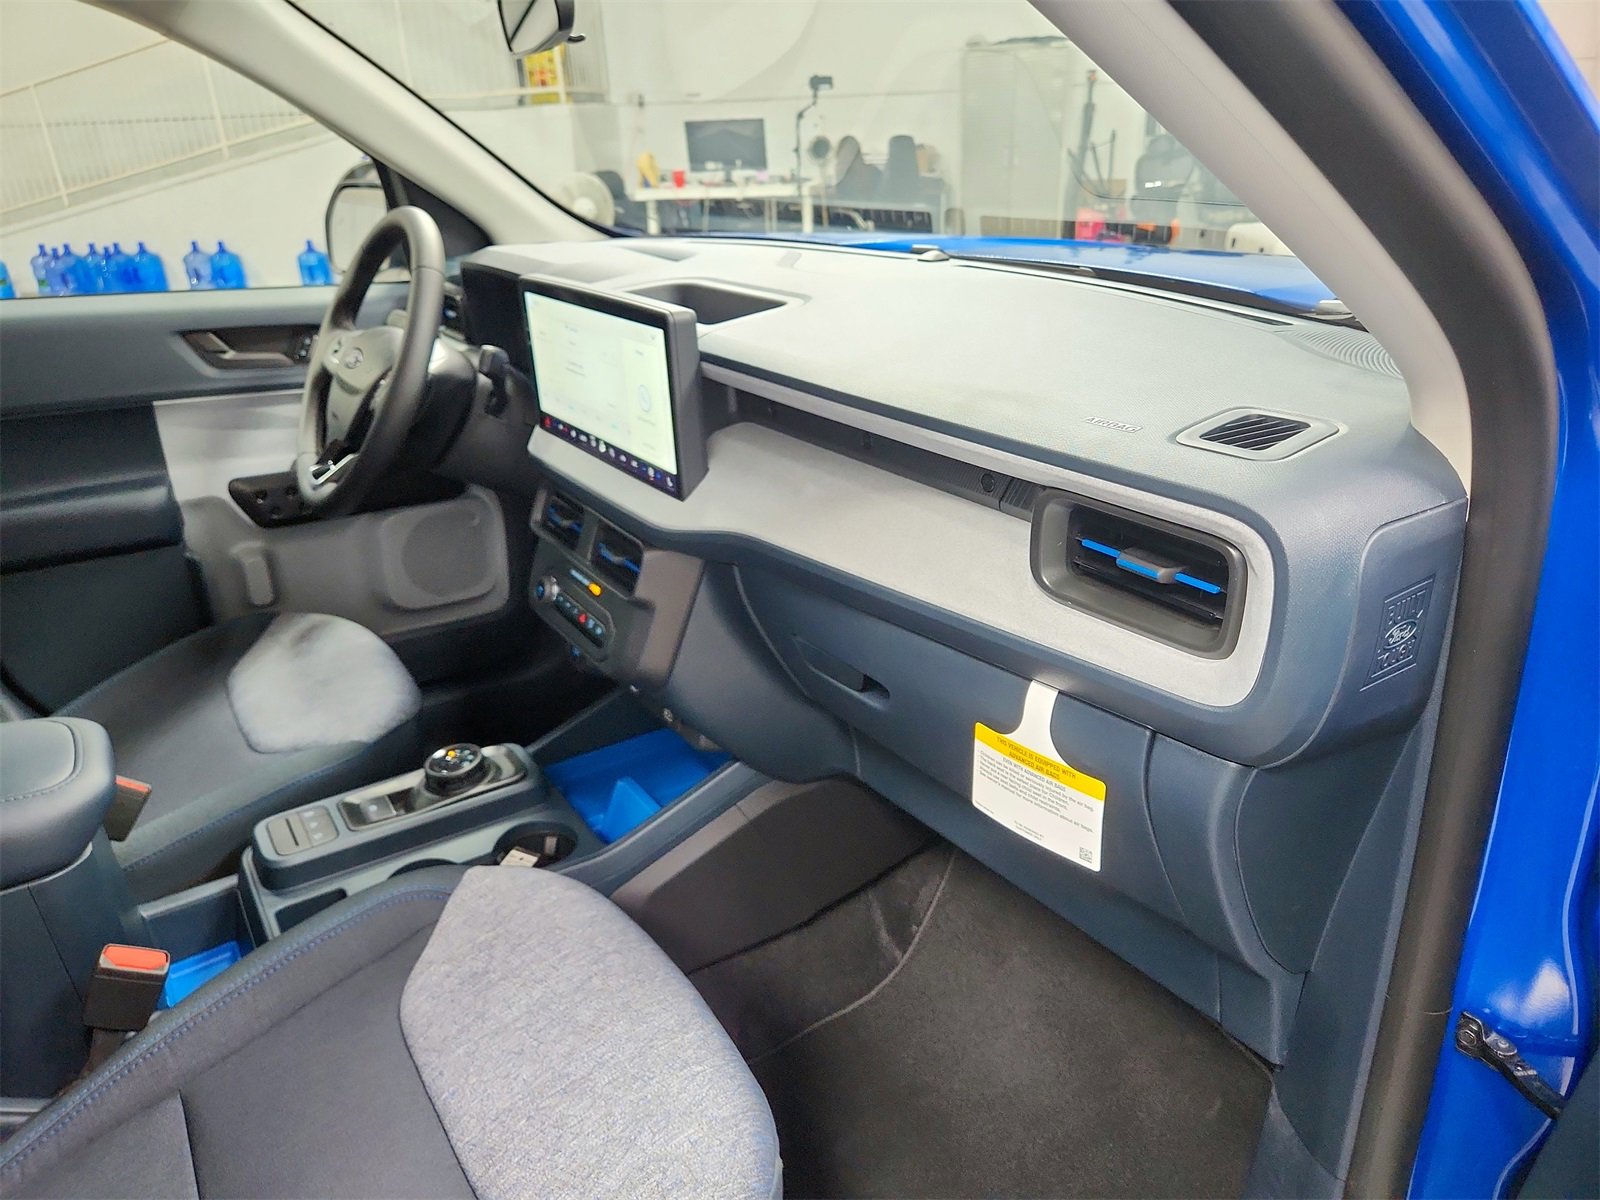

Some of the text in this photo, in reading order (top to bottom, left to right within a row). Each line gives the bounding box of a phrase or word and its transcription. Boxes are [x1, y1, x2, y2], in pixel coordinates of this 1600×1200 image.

[1083, 417, 1142, 433] AIRBAG
[1387, 590, 1427, 625] BUILT
[1388, 623, 1411, 644] Ford
[1377, 638, 1417, 668] TOUGH
[997, 737, 1007, 746] THIS
[1008, 743, 1026, 756] VEHICLE
[1035, 756, 1060, 772] EQUIPPED
[1062, 768, 1076, 779] WITH
[1009, 751, 1060, 780] ADVANCED AIR BAGS
[1014, 763, 1023, 771] WITH
[1025, 769, 1045, 782] ADVANCED
[1055, 783, 1065, 792] BAGS
